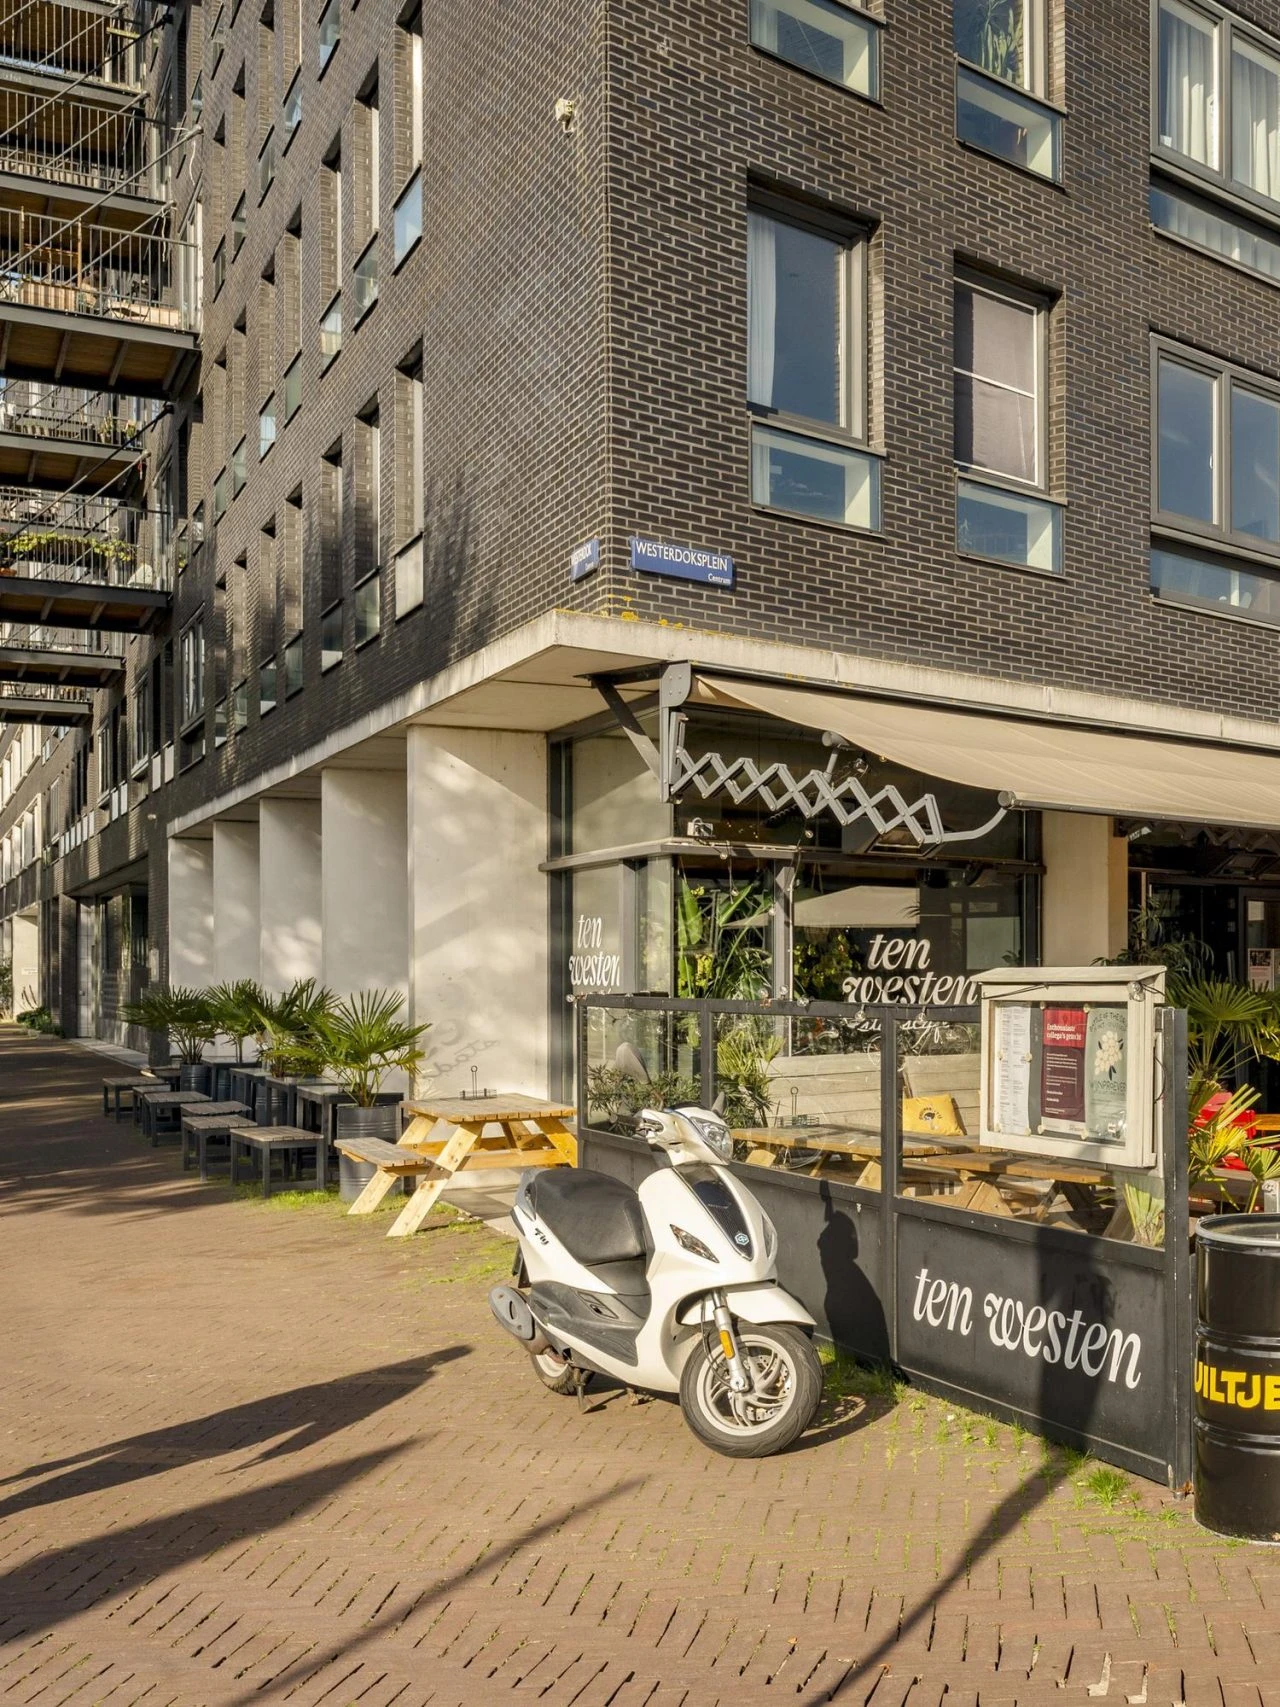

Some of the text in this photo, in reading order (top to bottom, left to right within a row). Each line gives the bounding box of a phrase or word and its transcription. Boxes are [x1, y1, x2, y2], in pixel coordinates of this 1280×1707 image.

[635, 540, 728, 572] WESTERDOKSPLEIN
[707, 573, 731, 585] Centrum
[577, 914, 603, 949] ten
[568, 950, 620, 987] westen
[867, 933, 931, 970] ten
[842, 971, 978, 1005] westen
[912, 1268, 1142, 1389] ten westen
